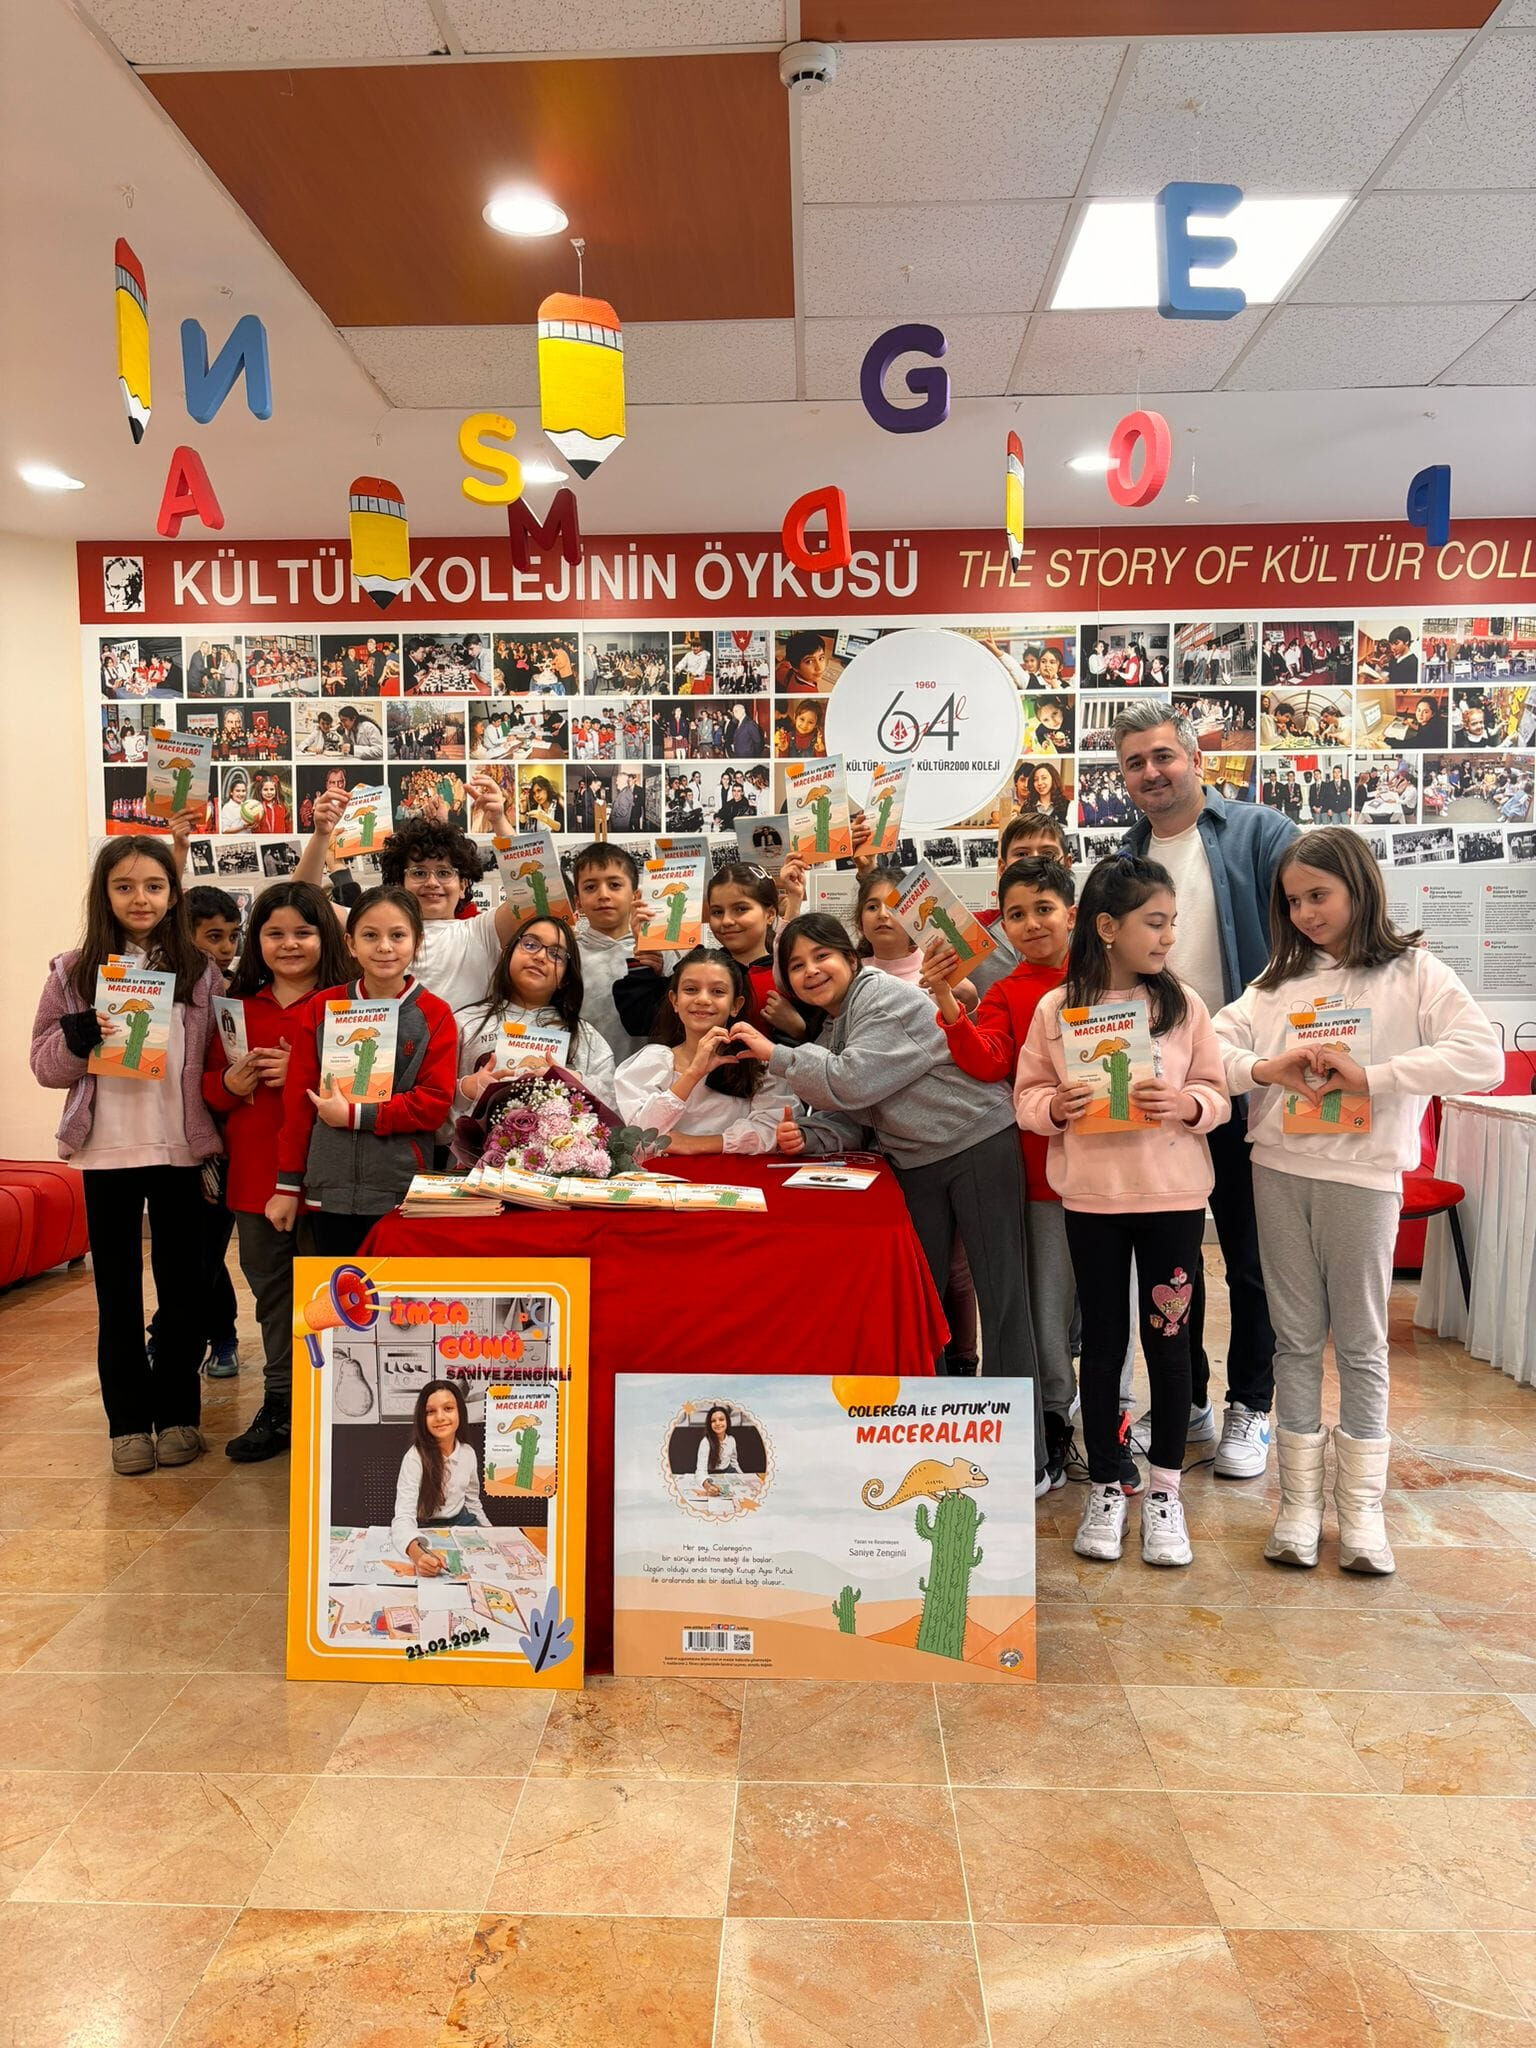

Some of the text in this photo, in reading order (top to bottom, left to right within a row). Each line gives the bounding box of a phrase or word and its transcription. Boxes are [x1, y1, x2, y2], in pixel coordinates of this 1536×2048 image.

[694, 538, 918, 600] ÖYKÜSÜ
[959, 533, 1536, 588] THE STORY OF KÜLTÜR COLL
[914, 680, 937, 690] 1960
[877, 690, 960, 755] 64
[917, 760, 1000, 772] KÜLTÜR2000 KOLEJİ
[793, 770, 835, 788] MACERALARI
[504, 847, 545, 860] MACERALARI
[107, 984, 162, 995] MACERALARI
[335, 1013, 387, 1024] MACERALARI
[1074, 1018, 1134, 1036] MACERALARI
[1297, 1025, 1357, 1039] MACERALARI
[508, 1040, 558, 1054] MACERALARI
[389, 1296, 469, 1326] İMZA
[438, 1330, 525, 1360] GÜNÜ
[446, 1364, 502, 1381] SANİYE
[503, 1364, 573, 1382] ZENGİNLİ
[495, 1400, 548, 1411] MACERALARI
[848, 1400, 1011, 1417] COLEREGA İLE PUTUK'UN
[856, 1419, 1003, 1444] MACERALARI
[848, 1547, 907, 1559] Saniye Zenginli
[666, 1565, 689, 1576] olduğu
[775, 1567, 793, 1575] Putuk
[405, 1626, 490, 1662] 21.02.2024
